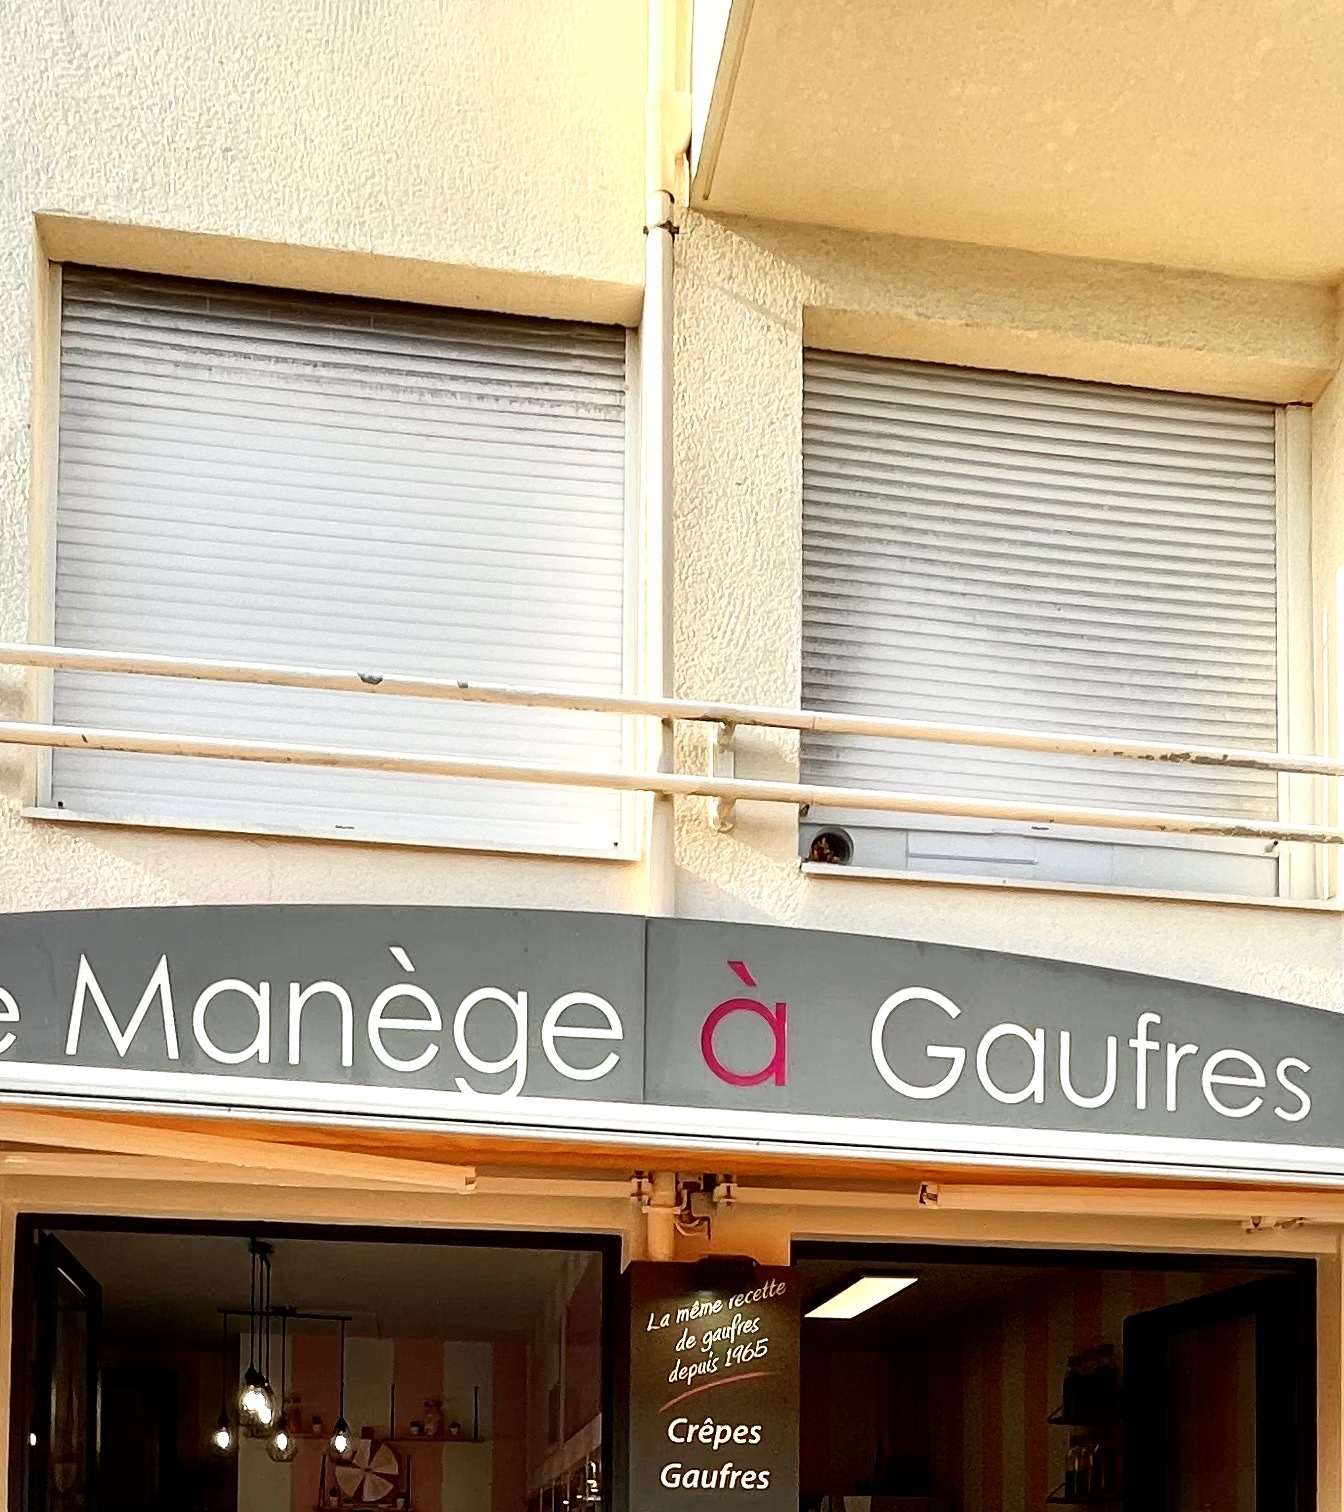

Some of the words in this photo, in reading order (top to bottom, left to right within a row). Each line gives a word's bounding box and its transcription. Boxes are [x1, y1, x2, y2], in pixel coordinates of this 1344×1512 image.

[65, 947, 623, 1096] Manège
[699, 961, 788, 1088] à
[869, 986, 1313, 1122] Gaufres
[647, 1313, 670, 1331] La
[676, 1299, 723, 1323] même
[728, 1278, 786, 1309] recette
[676, 1328, 696, 1352] de
[701, 1313, 760, 1352] gaufres
[669, 1351, 719, 1385] depuis
[725, 1338, 769, 1367] 1965
[667, 1418, 762, 1449] Crêpes
[659, 1463, 770, 1490] Gaufres
